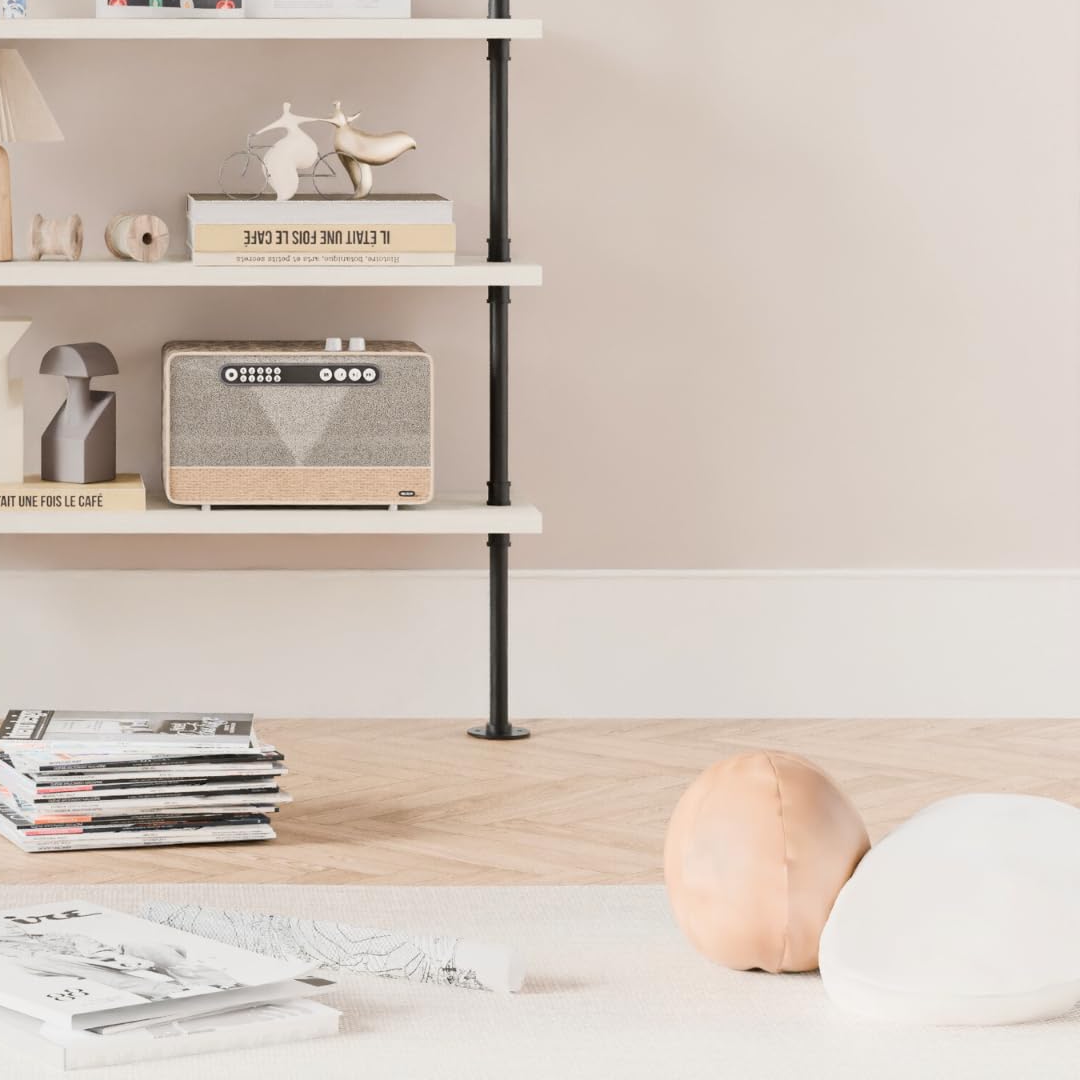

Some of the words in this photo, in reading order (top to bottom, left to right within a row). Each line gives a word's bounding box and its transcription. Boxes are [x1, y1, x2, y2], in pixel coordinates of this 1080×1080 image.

[243, 230, 272, 247] CAFÉ
[275, 230, 289, 244] LE
[292, 230, 316, 245] FOIS
[320, 230, 342, 245] UNE
[345, 230, 377, 247] ÉTAIT
[379, 230, 390, 244] IL
[268, 255, 291, 263] petits
[18, 495, 38, 507] UNE
[40, 495, 62, 507] FOIS
[64, 495, 76, 507] LE
[78, 493, 103, 507] CAFÉ
